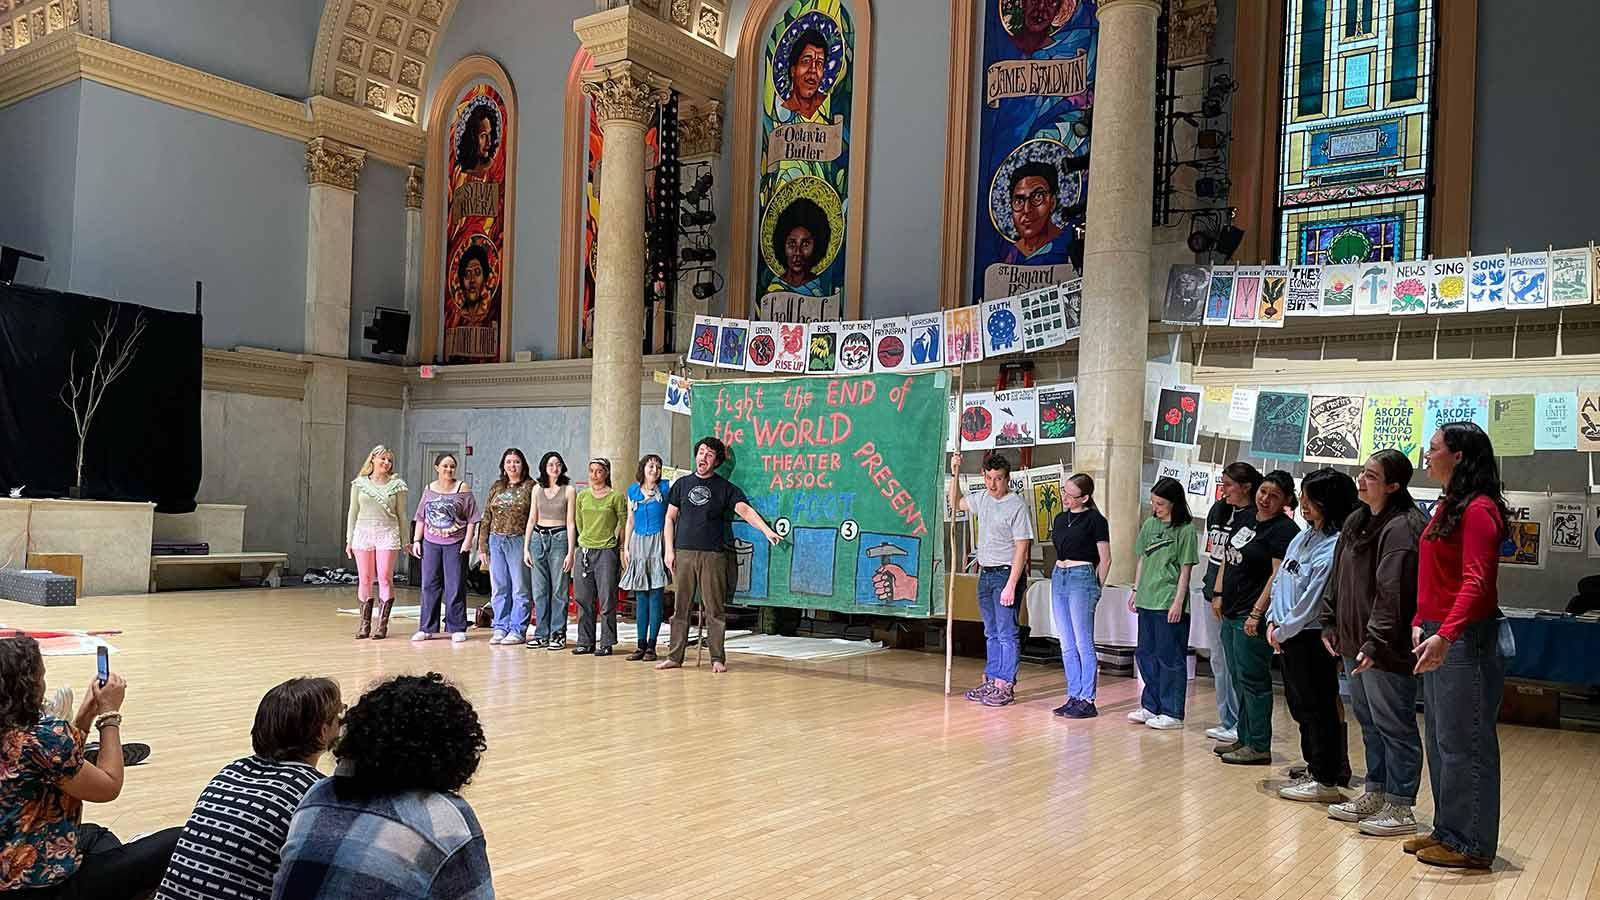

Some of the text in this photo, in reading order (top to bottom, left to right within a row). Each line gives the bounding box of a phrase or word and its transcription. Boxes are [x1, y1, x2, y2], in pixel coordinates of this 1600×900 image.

[990, 59, 1084, 97] JAMES BALDWIN
[784, 127, 827, 143] Octavia
[785, 143, 823, 160] Butler
[1473, 259, 1505, 271] SONG
[1510, 257, 1546, 267] HAPPINESS
[1397, 265, 1426, 278] NEWS
[1434, 262, 1464, 276] SING
[1009, 266, 1054, 289] Bayard
[989, 302, 1011, 312] EARTH
[817, 325, 830, 333] RISE
[775, 360, 804, 371] RISE UP
[715, 386, 764, 419] fight
[784, 386, 813, 421] the
[827, 381, 875, 406] END
[889, 378, 914, 411] of
[994, 392, 1011, 402] NOT
[1582, 397, 1600, 412] A
[1375, 408, 1414, 417] ABCDEF
[1435, 408, 1477, 418] ABCDEF
[714, 412, 852, 458] the WORLD
[1373, 441, 1396, 450] XYZ
[761, 453, 841, 472] THEATER
[1163, 466, 1180, 477] RIOT
[770, 473, 833, 490] ASSOC.
[853, 441, 928, 537] PRESENT
[778, 522, 787, 533] 2
[844, 522, 853, 538] 3
